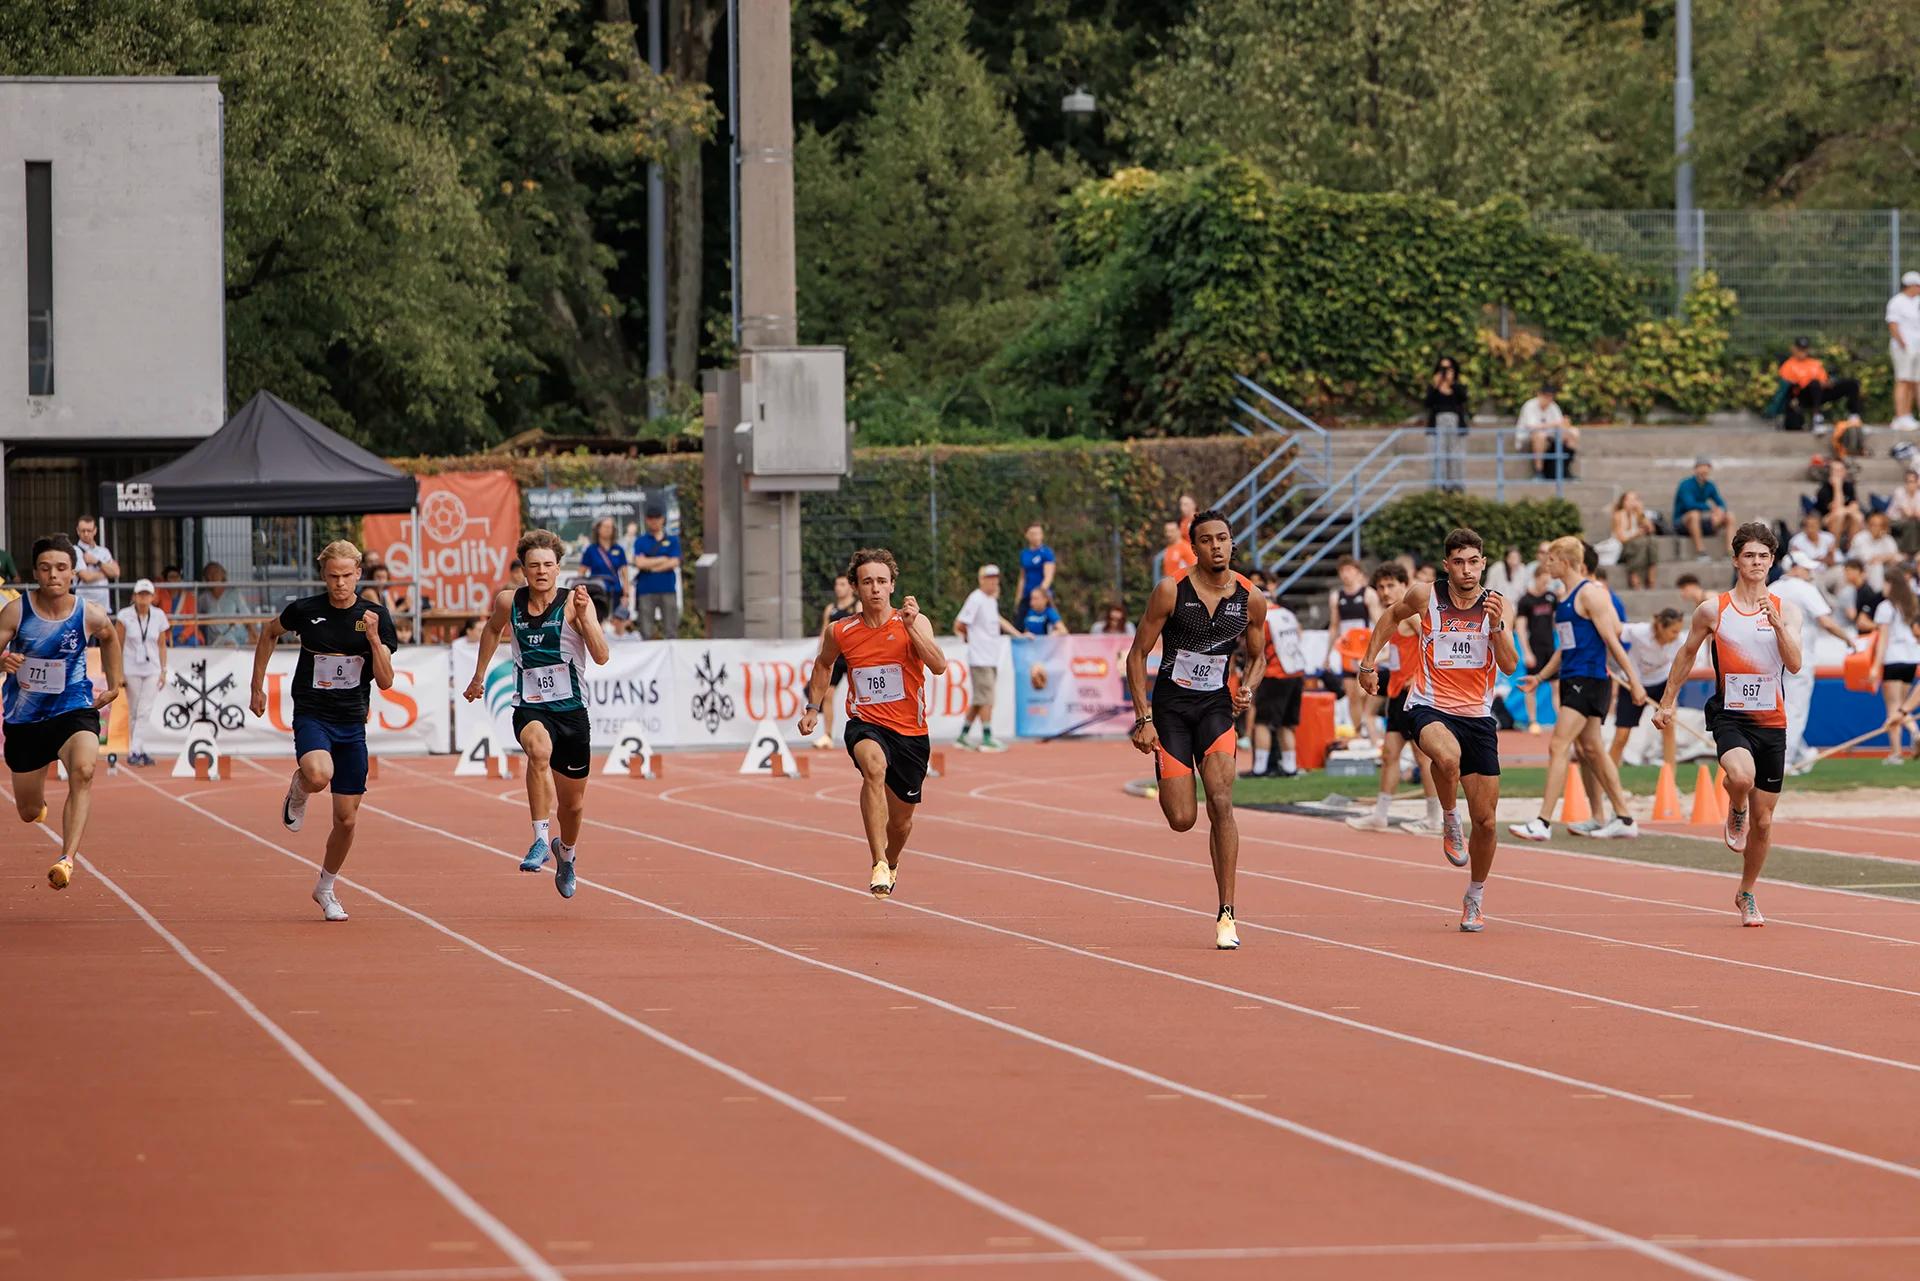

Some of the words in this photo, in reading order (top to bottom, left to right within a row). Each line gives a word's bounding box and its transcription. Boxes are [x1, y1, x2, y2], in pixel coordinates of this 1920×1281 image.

[385, 538, 508, 582] Quality
[527, 633, 545, 645] TSV
[1452, 641, 1471, 654] 440
[29, 667, 47, 680] 771
[336, 665, 343, 676] 6
[1192, 663, 1211, 677] 482
[537, 675, 554, 689] 463
[867, 676, 886, 691] 768
[584, 679, 659, 705] UANS
[1742, 684, 1761, 697] 657
[188, 738, 214, 769] 6
[469, 737, 490, 762] 4
[620, 736, 646, 769] 3
[757, 736, 780, 769] 2
